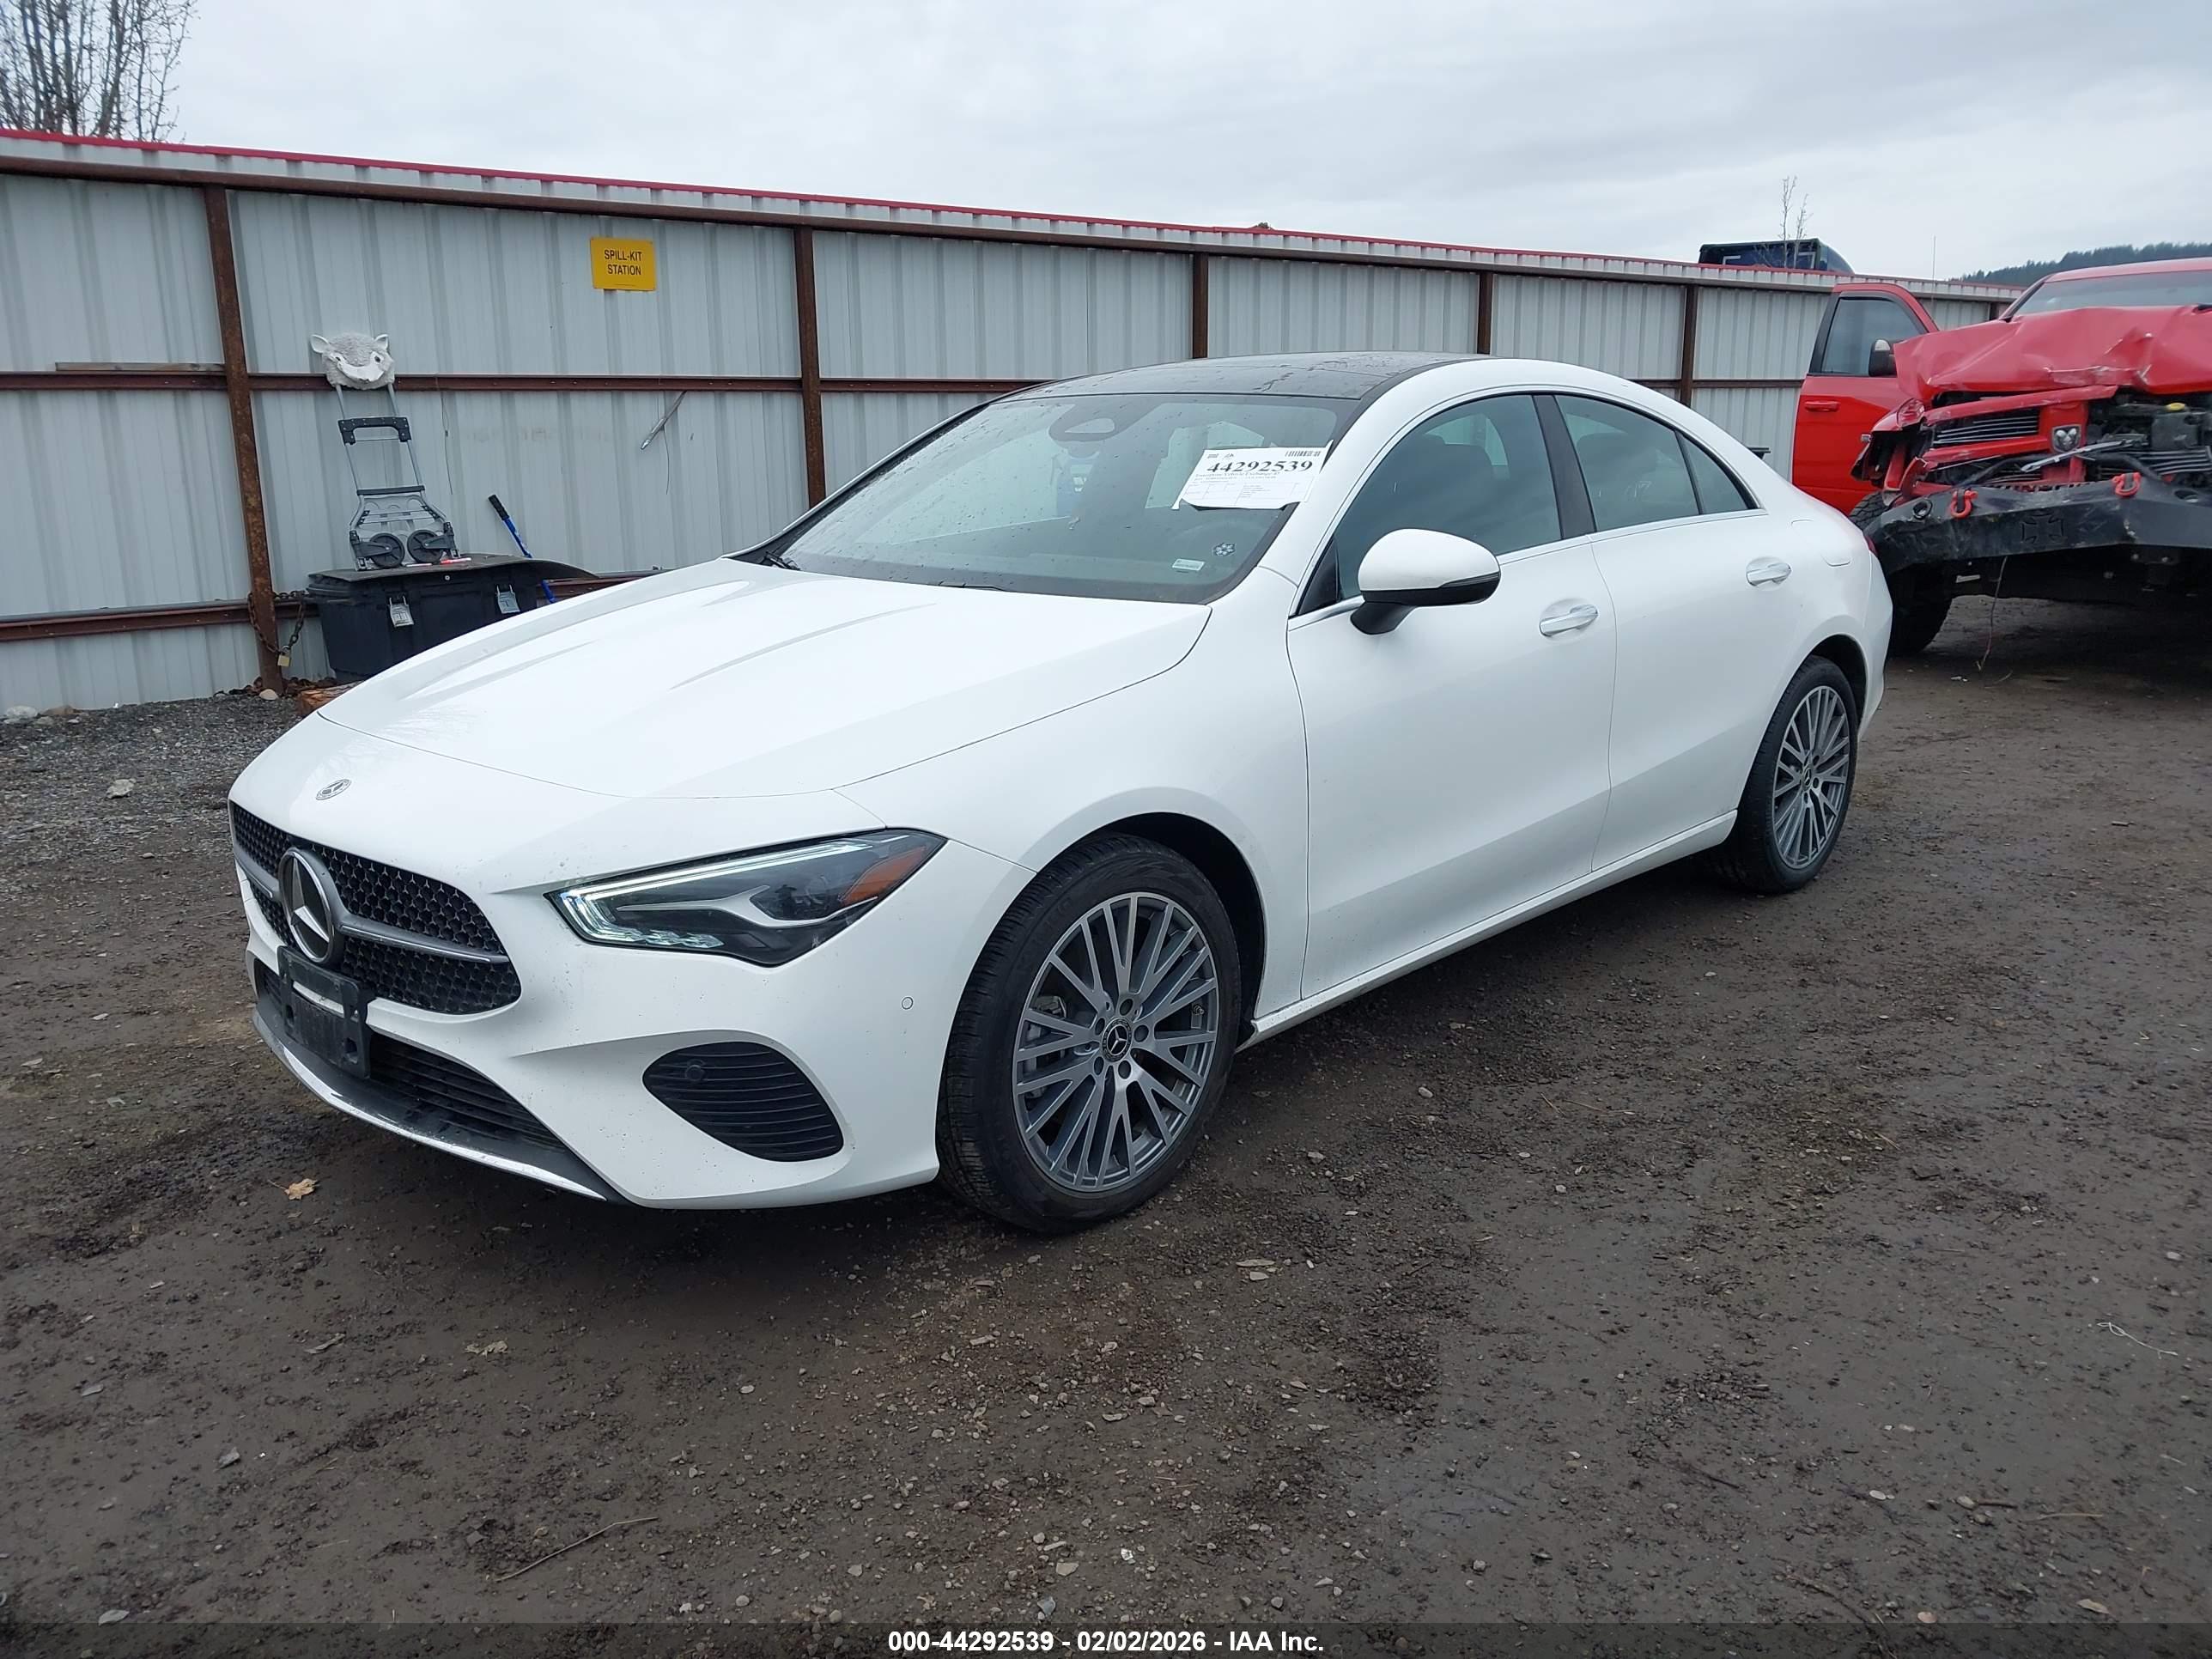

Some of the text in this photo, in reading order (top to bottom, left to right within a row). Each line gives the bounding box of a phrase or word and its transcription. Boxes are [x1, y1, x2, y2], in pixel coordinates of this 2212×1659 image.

[605, 249, 642, 261] SPILL-KIT
[607, 264, 641, 276] STATION
[1206, 460, 1313, 472] 44292539
